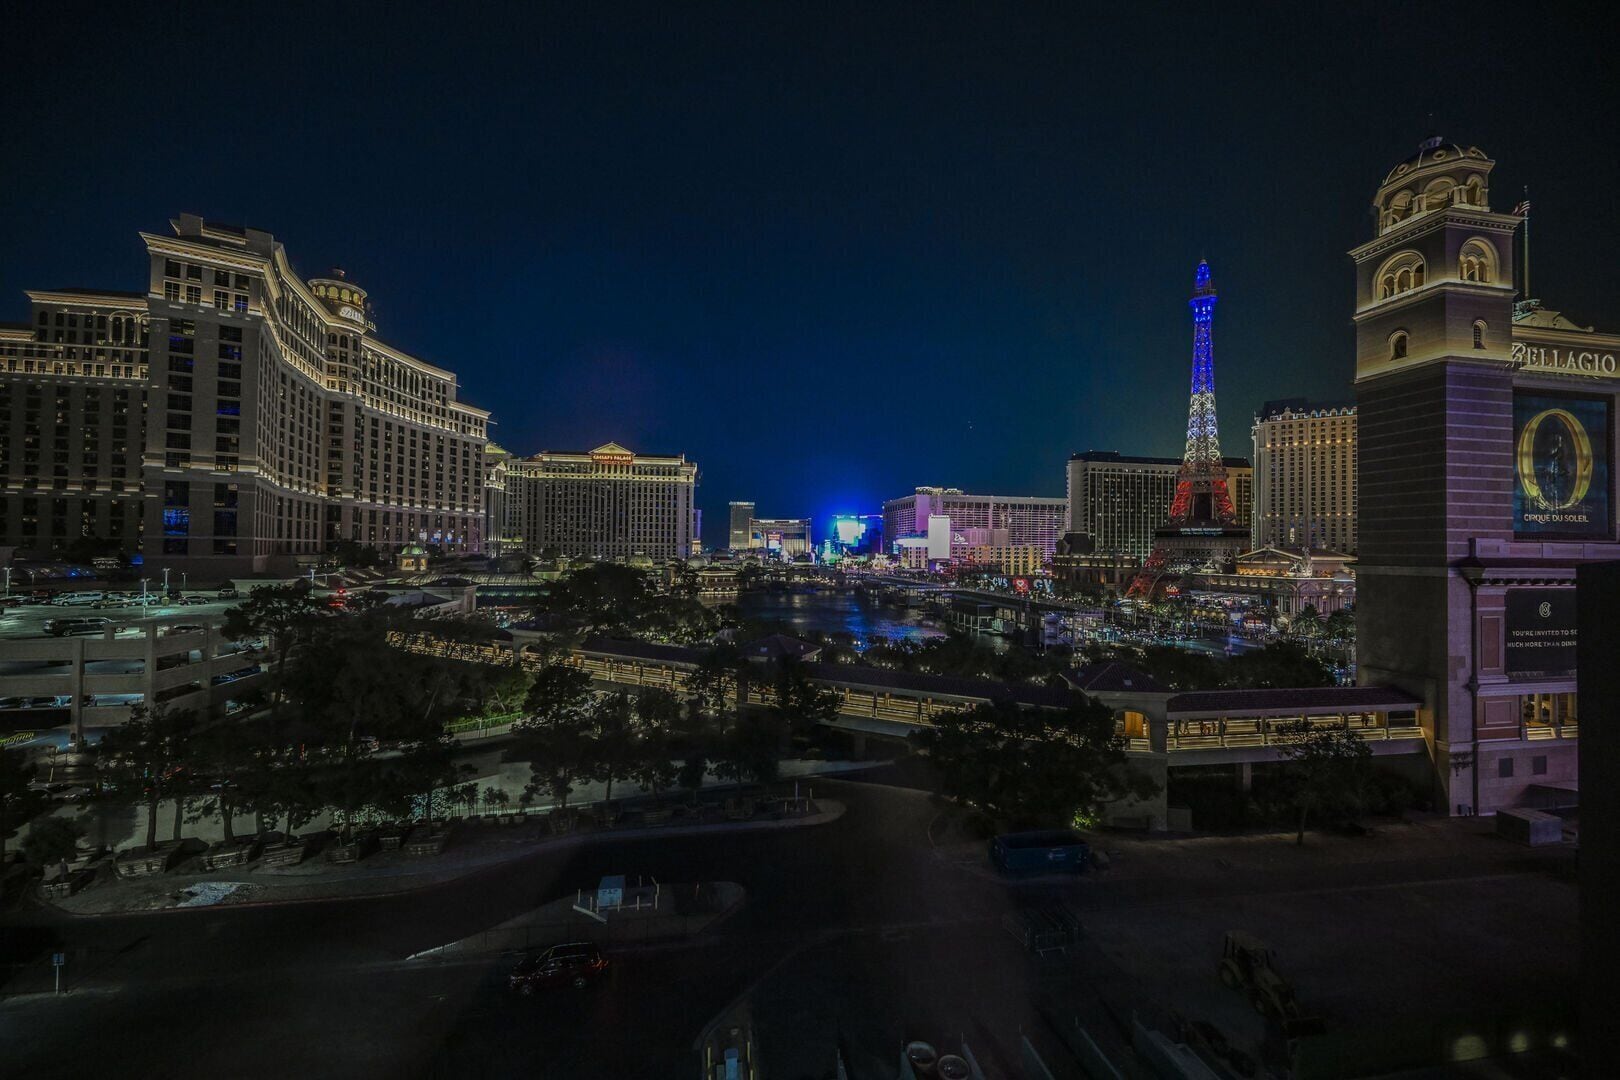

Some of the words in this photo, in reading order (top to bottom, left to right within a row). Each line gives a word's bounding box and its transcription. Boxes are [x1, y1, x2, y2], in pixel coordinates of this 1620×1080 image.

[1511, 342, 1616, 374] BELLAGIO
[1523, 513, 1551, 524] CIRQUE
[1552, 514, 1563, 522] DU
[1564, 514, 1590, 523] SOLEIL
